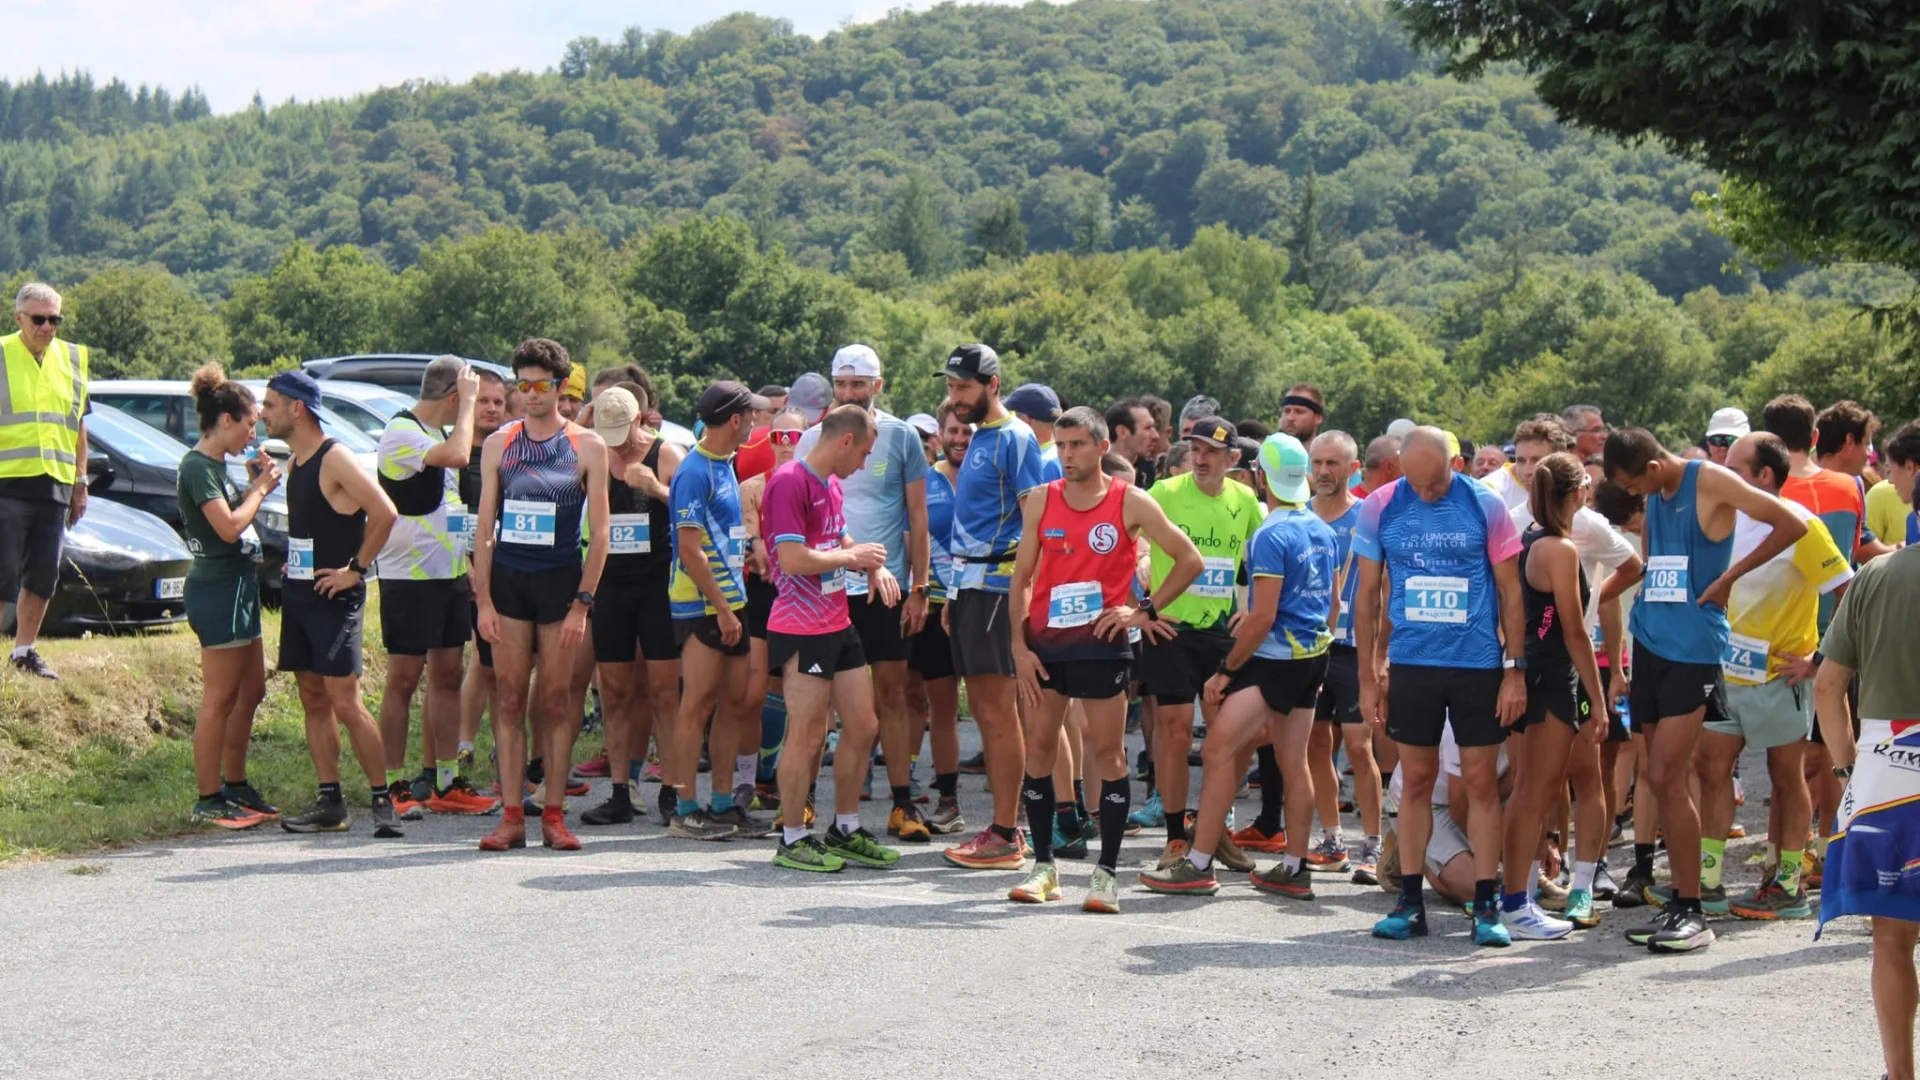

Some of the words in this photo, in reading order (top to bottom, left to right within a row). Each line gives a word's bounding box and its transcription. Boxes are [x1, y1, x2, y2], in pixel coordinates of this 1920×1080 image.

[514, 514, 537, 532] 81
[612, 526, 635, 542] 82
[1400, 540, 1468, 550] TRIATHLON
[1204, 570, 1226, 586] 14
[1650, 570, 1679, 588] 108
[1060, 596, 1088, 615] 55
[1417, 590, 1459, 609] 110
[1731, 646, 1752, 666] 74
